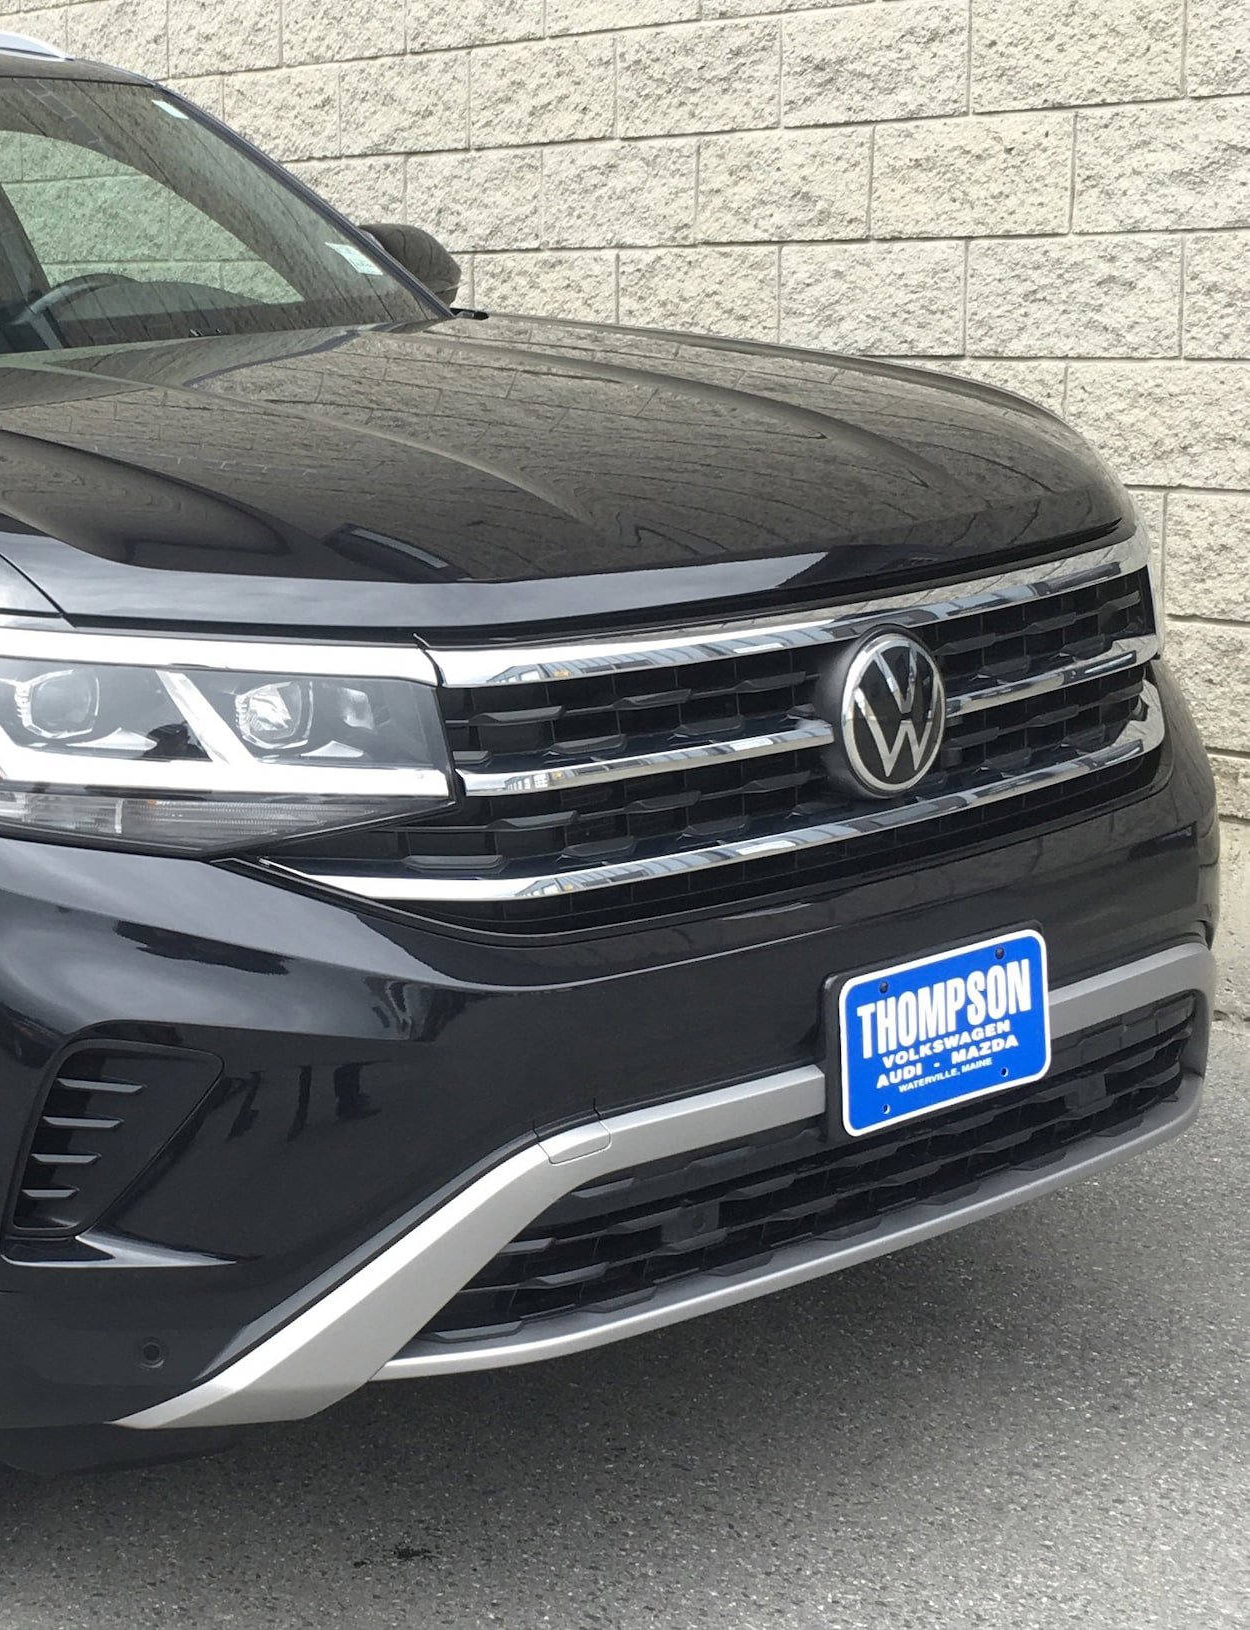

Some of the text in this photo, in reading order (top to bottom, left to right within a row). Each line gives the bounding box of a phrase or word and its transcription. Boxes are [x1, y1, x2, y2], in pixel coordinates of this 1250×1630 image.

[857, 958, 1032, 1059] THOMPSON
[876, 1062, 923, 1089] AUDI
[951, 1034, 1019, 1065] MAZDA
[882, 1019, 1011, 1069] VOLKSWAGEN
[898, 1057, 993, 1093] WATERVILLE, MAINE
